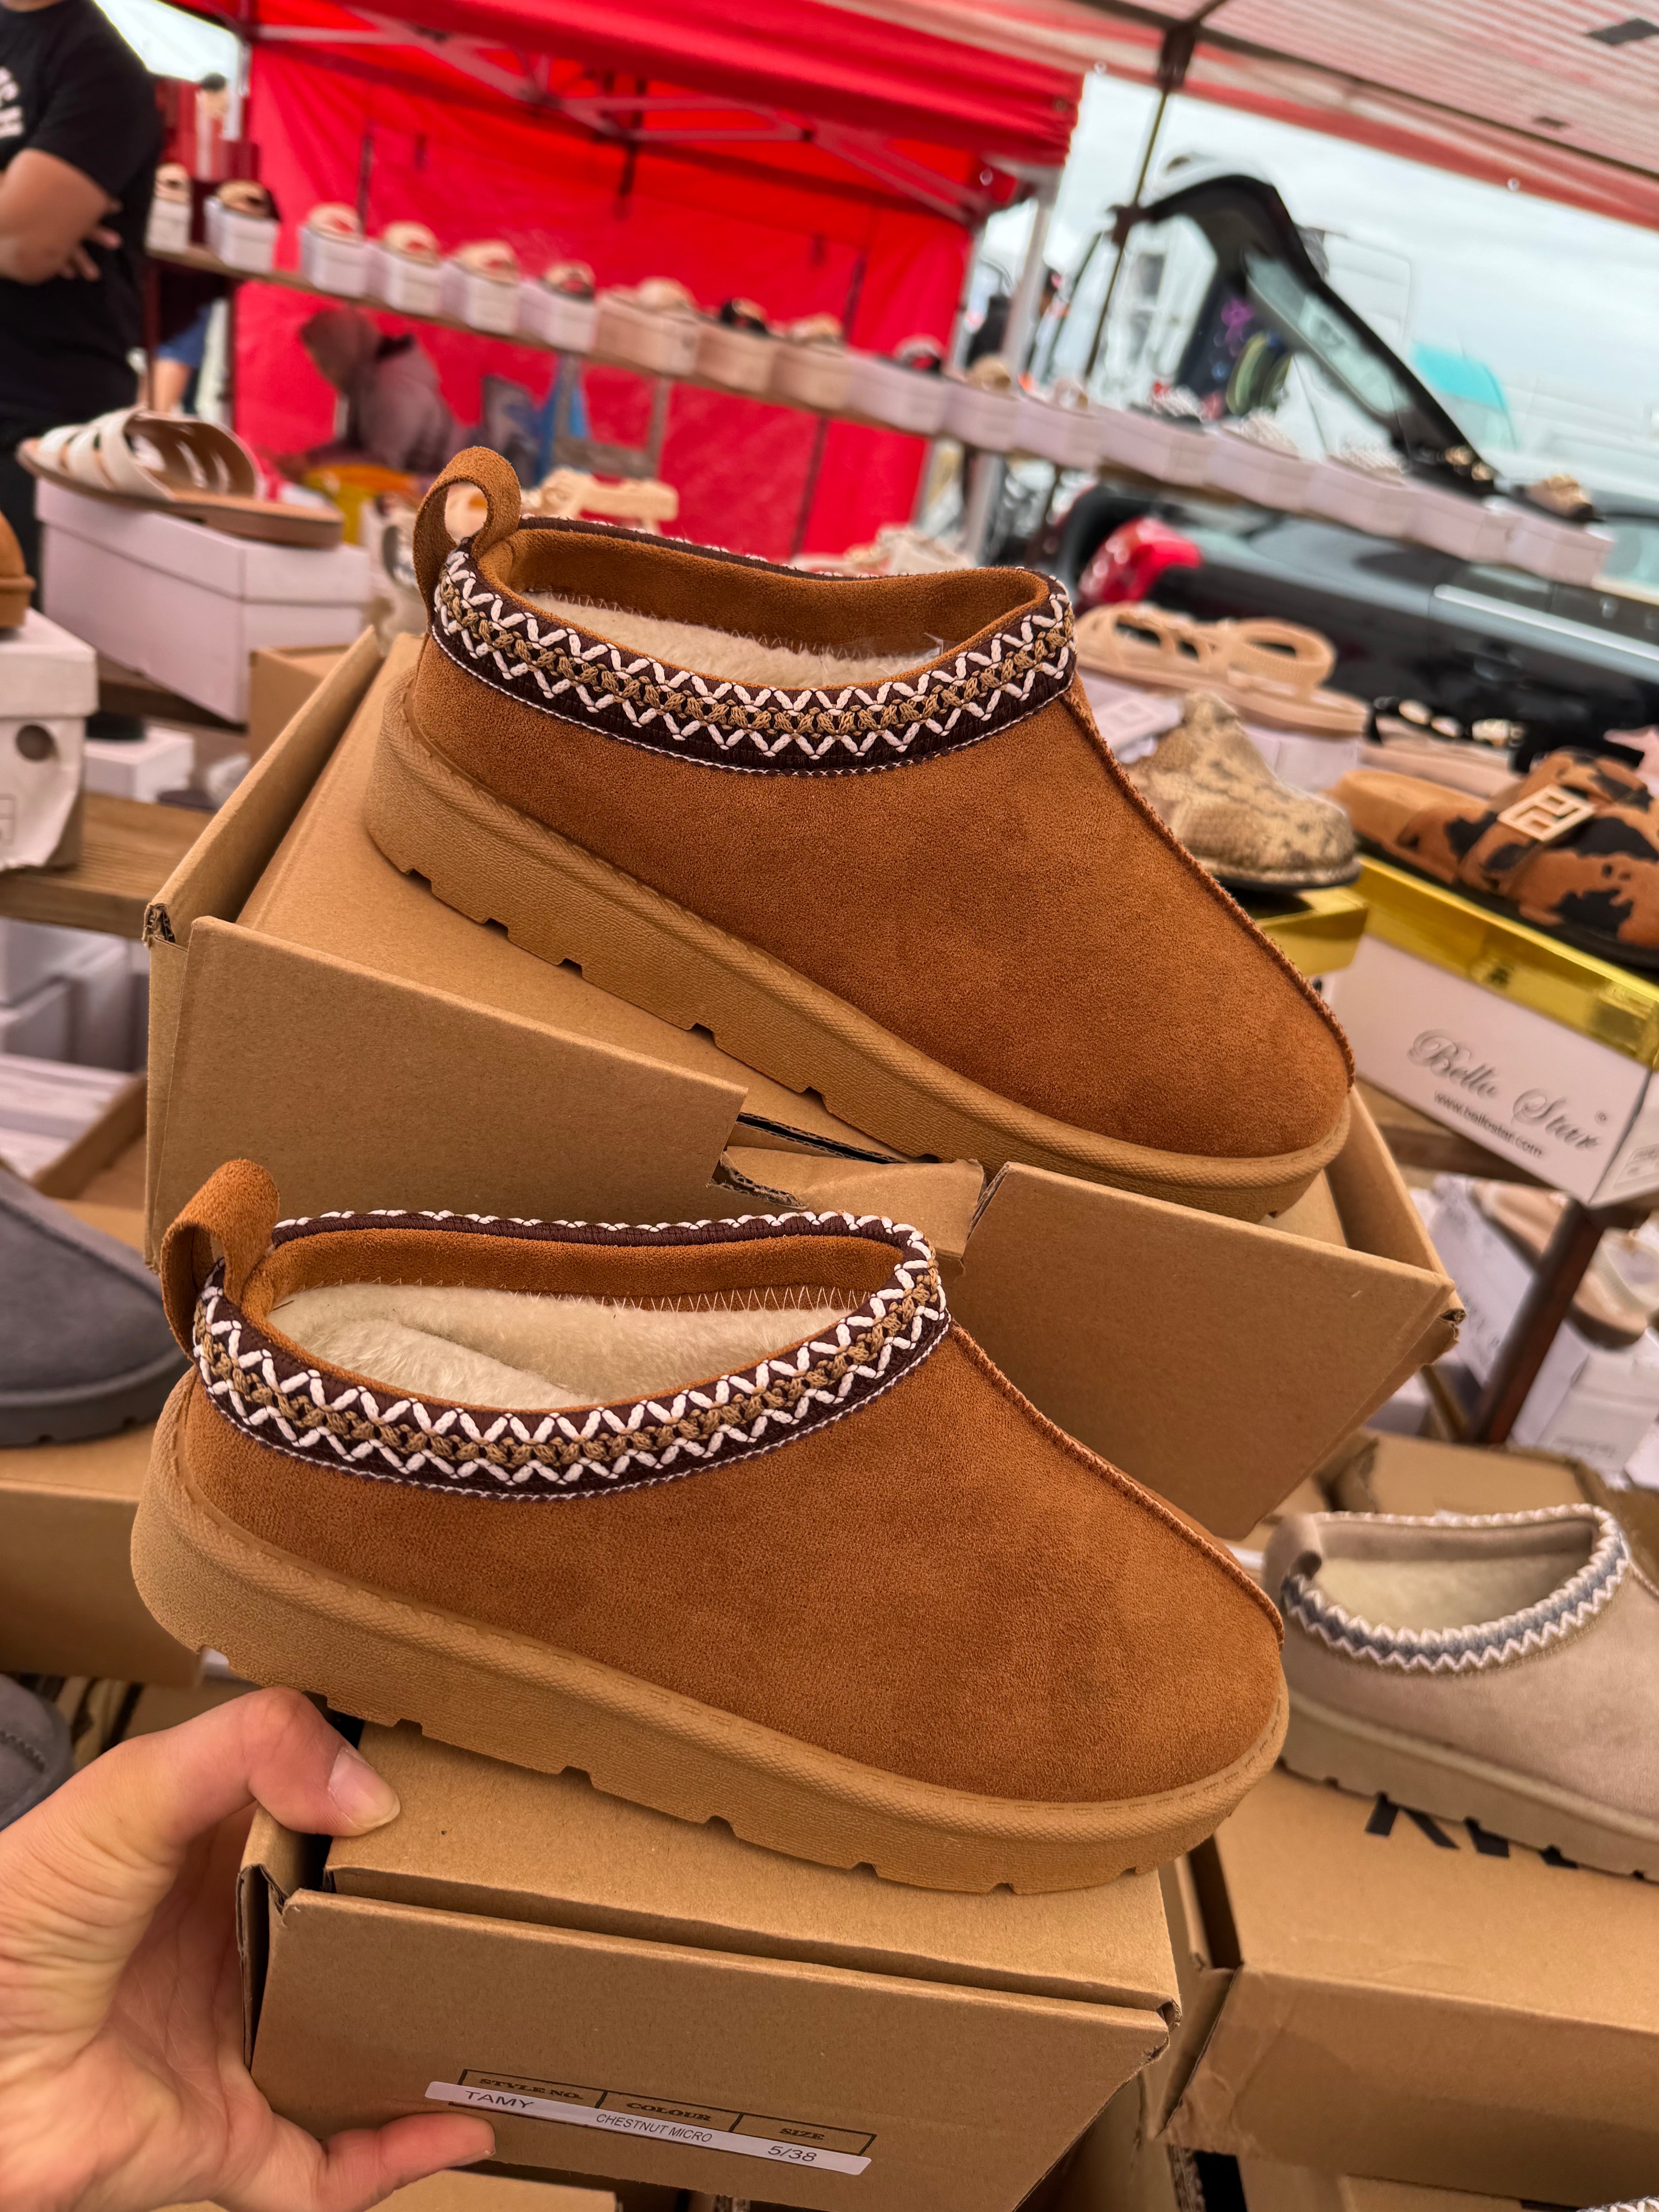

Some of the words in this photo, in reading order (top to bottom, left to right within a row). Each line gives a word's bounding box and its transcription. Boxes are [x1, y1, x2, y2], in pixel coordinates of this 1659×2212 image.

[1511, 1088, 1599, 1151] Star
[479, 2078, 545, 2093] STYLE
[465, 2090, 534, 2109] TAMY
[626, 2102, 712, 2121] COLOUR
[596, 2113, 668, 2135] CHESTNUT
[668, 2126, 713, 2143] MICRO
[779, 2127, 825, 2141] SIZE
[768, 2145, 817, 2162] 5/38
